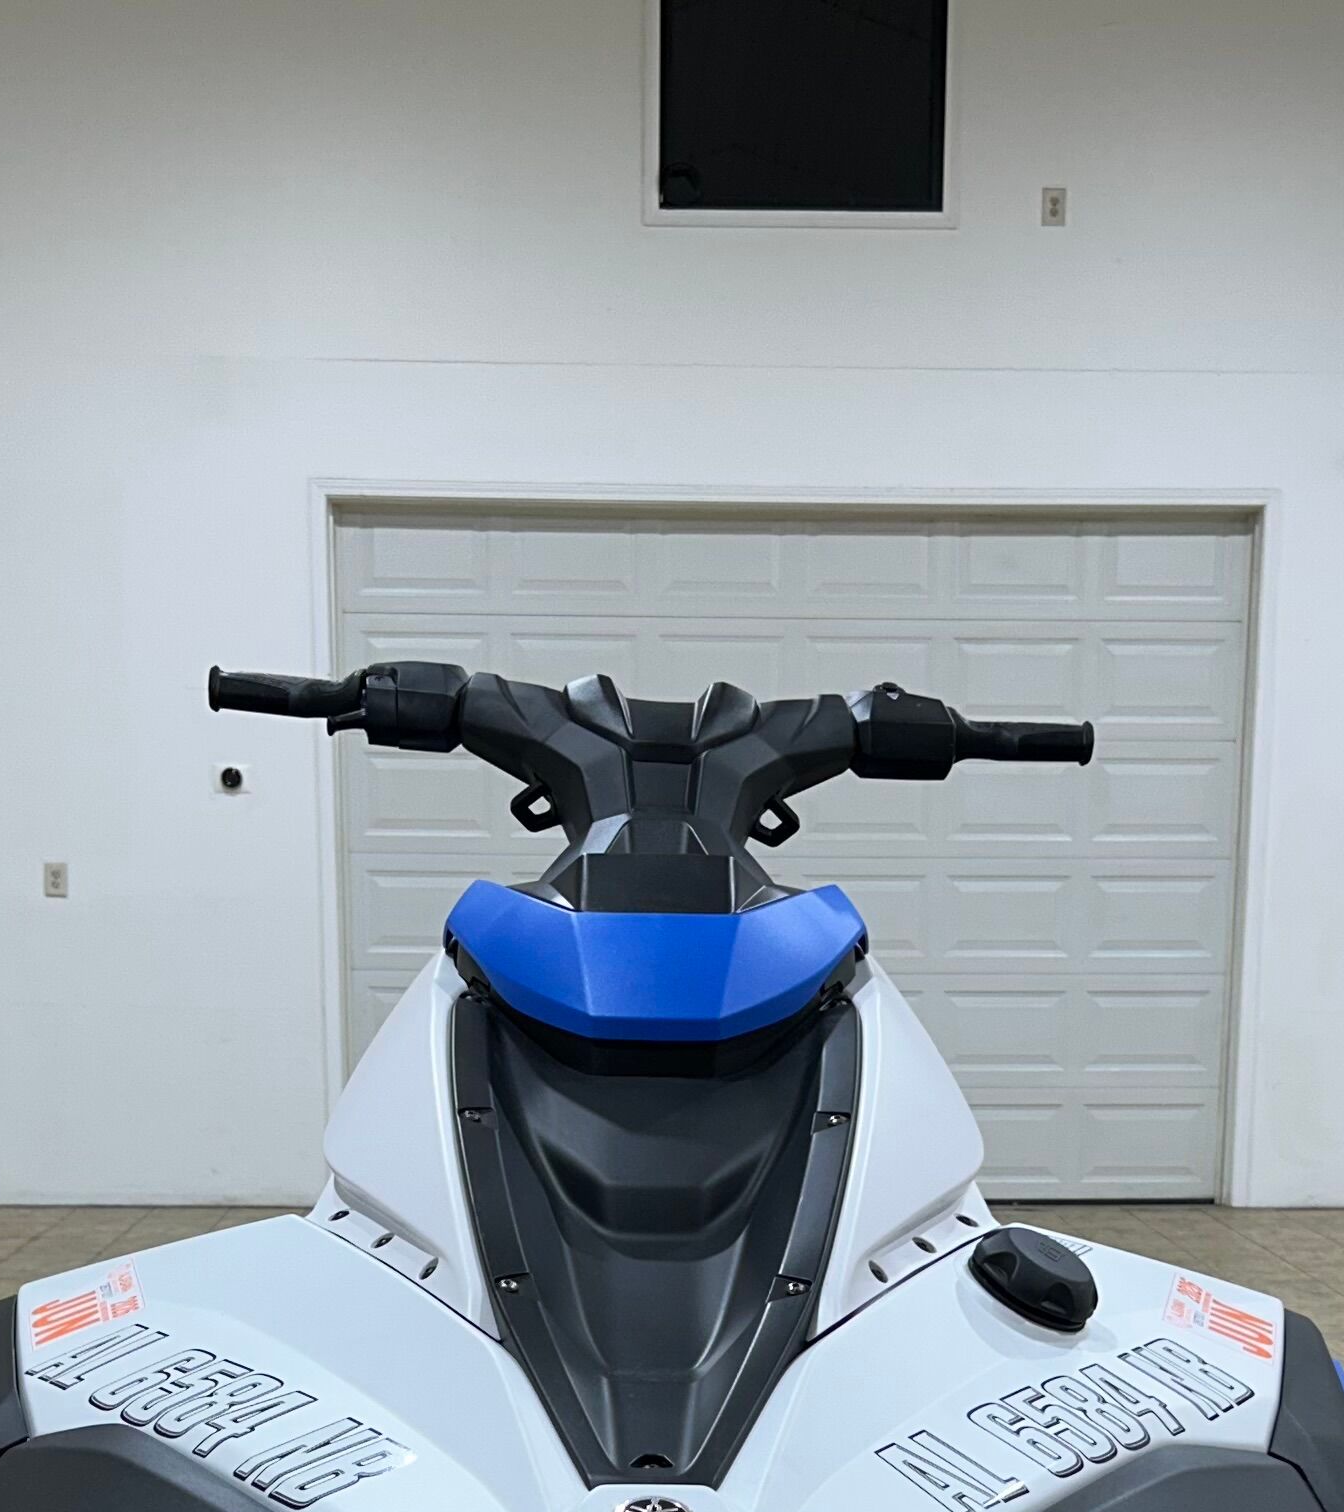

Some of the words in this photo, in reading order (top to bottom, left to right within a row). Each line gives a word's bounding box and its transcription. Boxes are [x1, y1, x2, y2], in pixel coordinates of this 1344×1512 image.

[24, 1323, 170, 1391] AL
[32, 1290, 101, 1346] JUN
[1208, 1298, 1274, 1359] JUN
[88, 1348, 319, 1458] 6584
[966, 1363, 1186, 1478] 6584
[1117, 1337, 1255, 1421] NB
[233, 1416, 418, 1511] NB
